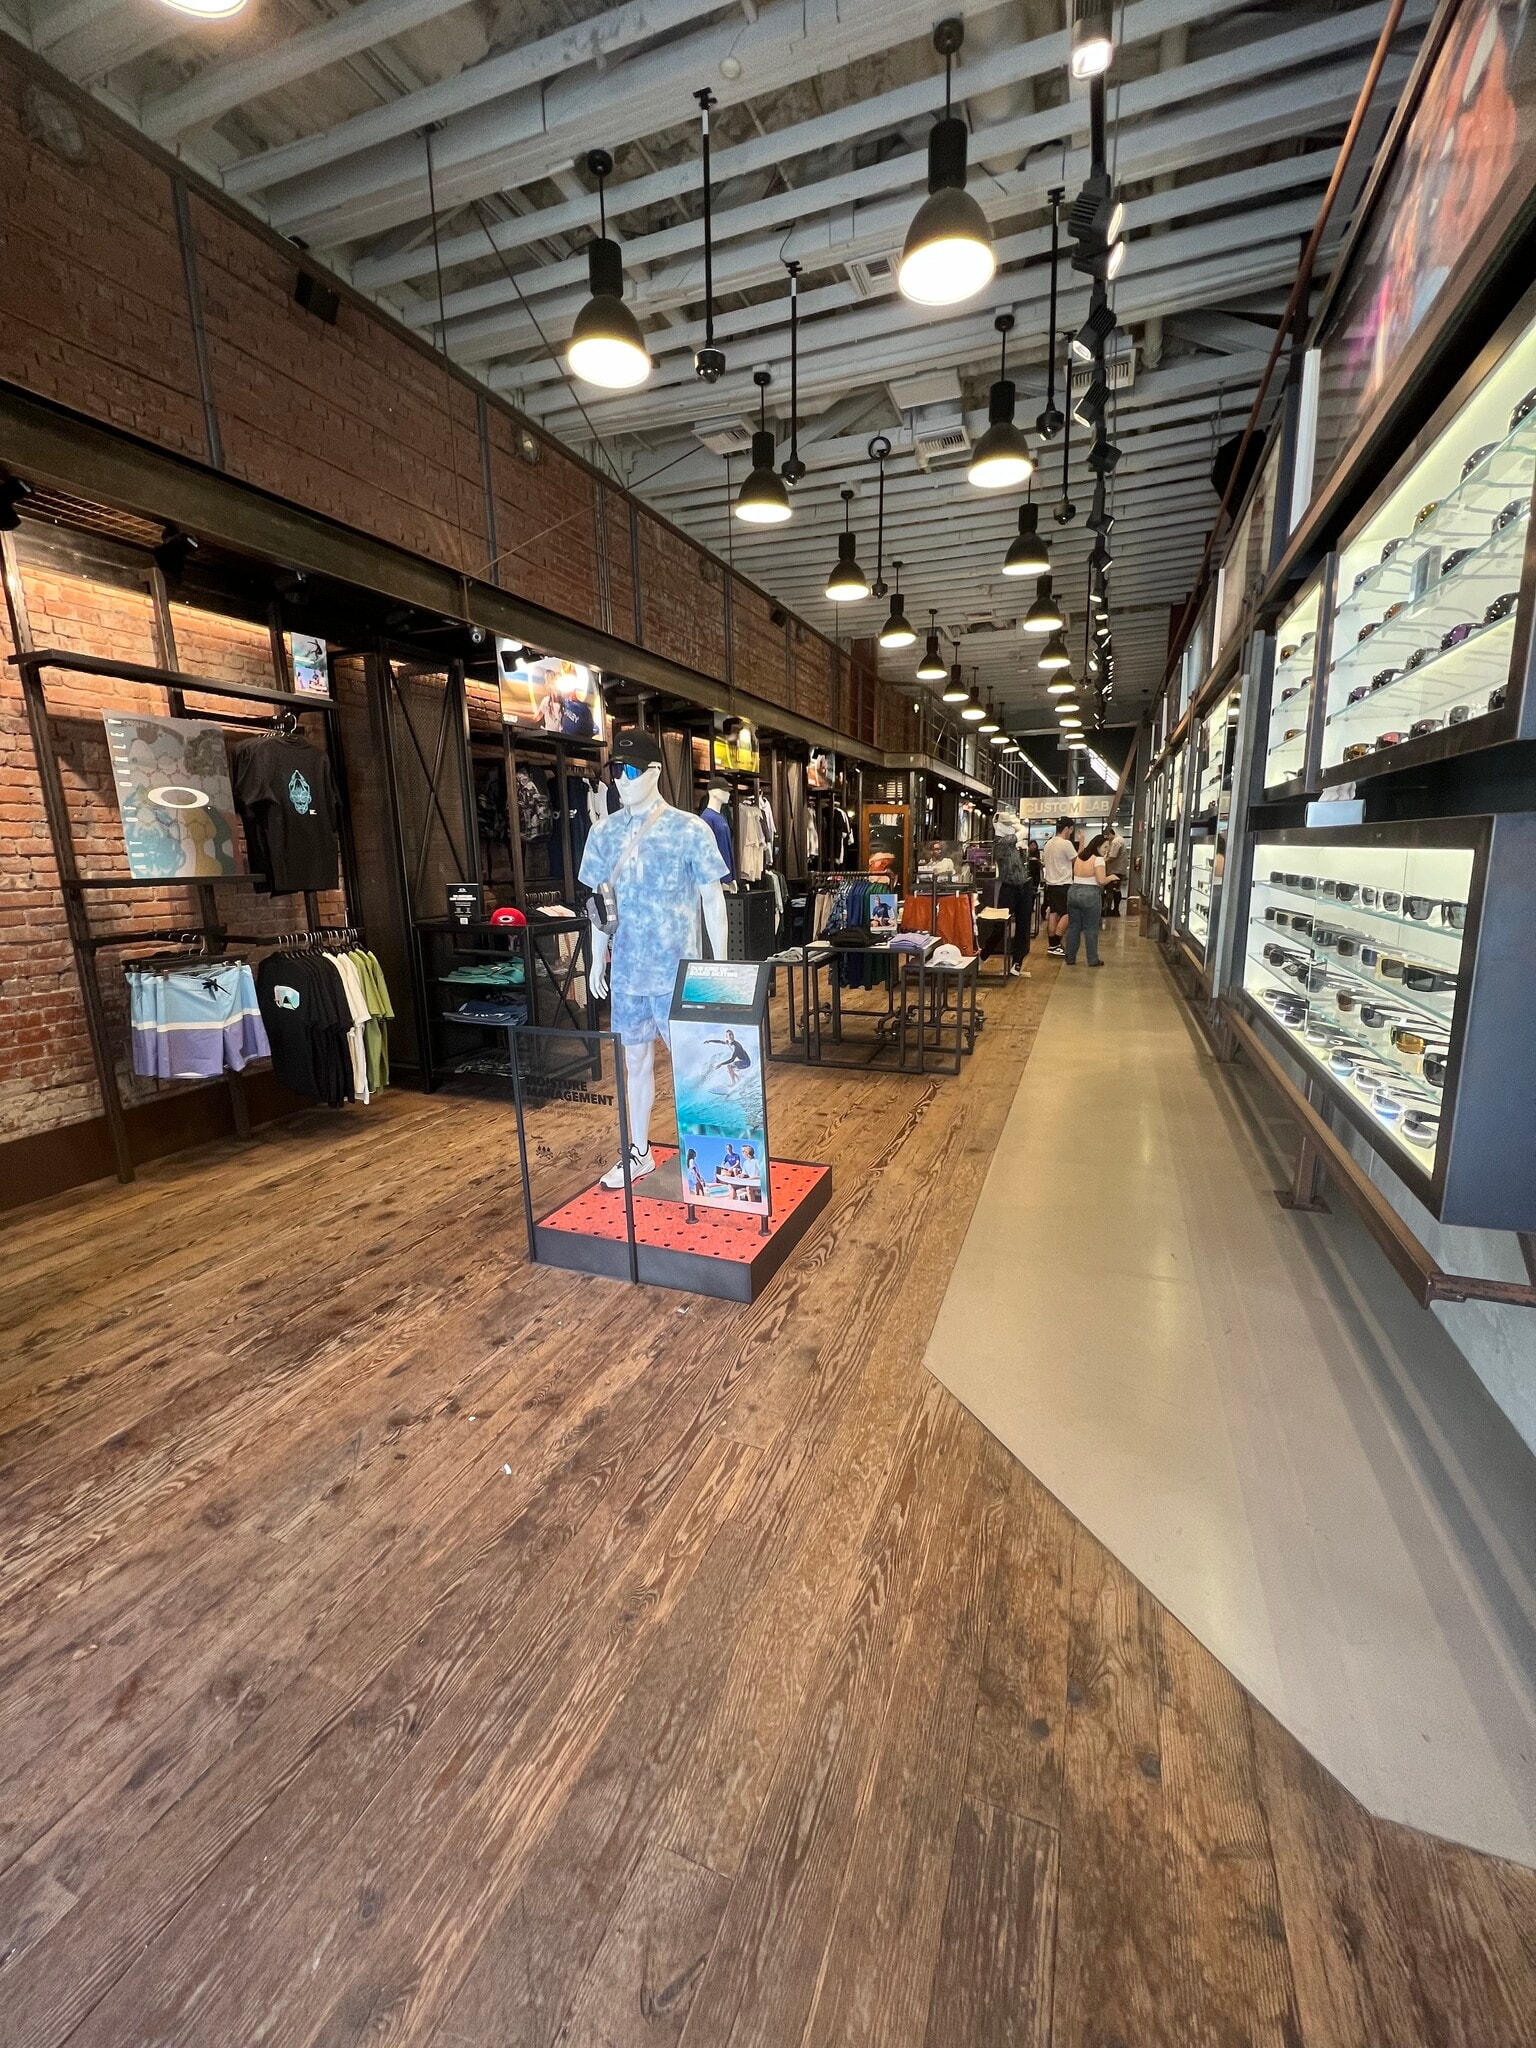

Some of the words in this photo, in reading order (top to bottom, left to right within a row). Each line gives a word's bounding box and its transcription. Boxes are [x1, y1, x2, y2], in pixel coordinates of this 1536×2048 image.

[1027, 802, 1080, 814] CUSTOM
[1085, 800, 1110, 812] LAB
[526, 1086, 614, 1106] MANAGEMENT
